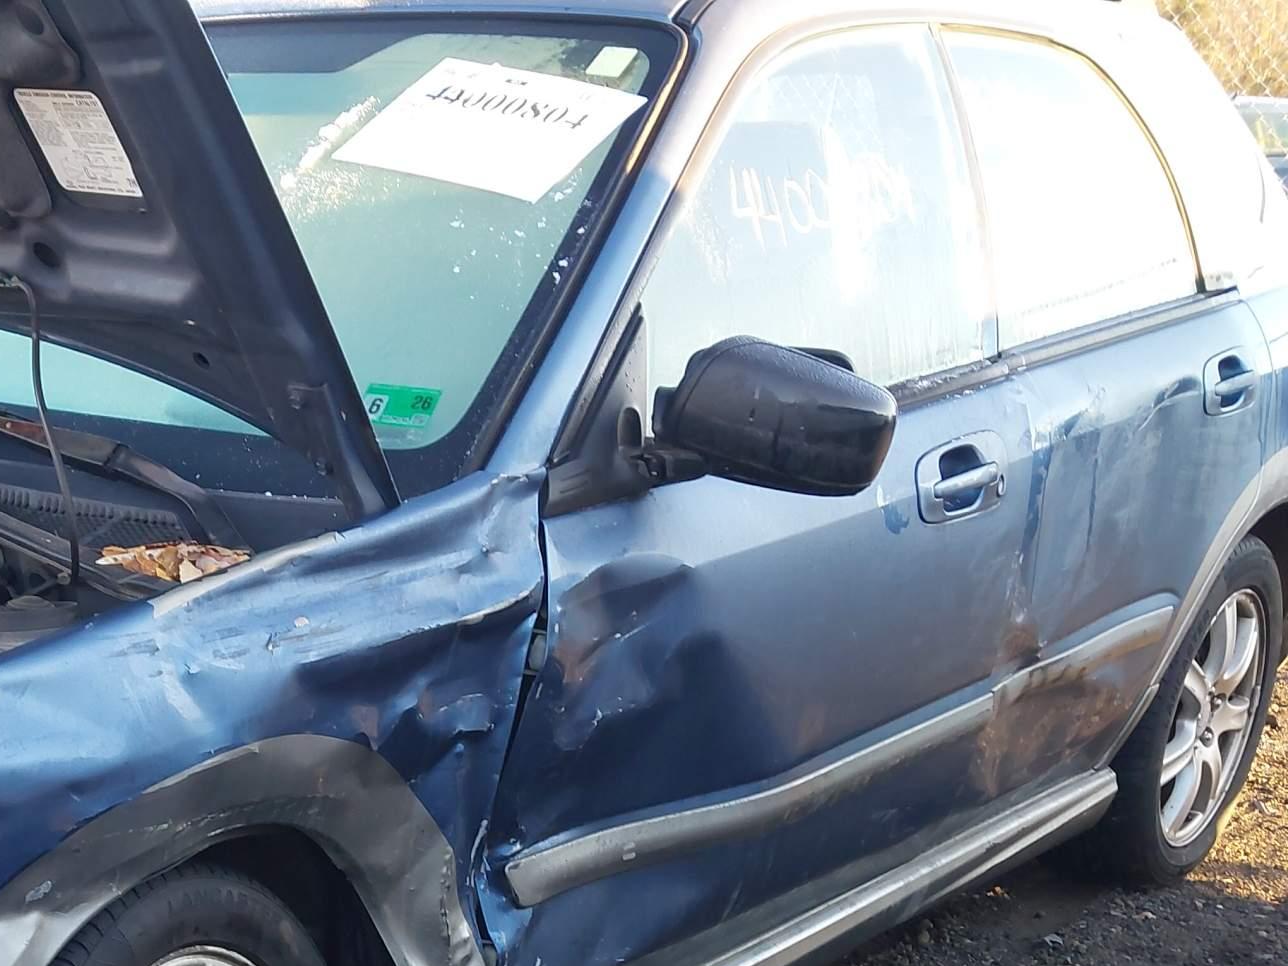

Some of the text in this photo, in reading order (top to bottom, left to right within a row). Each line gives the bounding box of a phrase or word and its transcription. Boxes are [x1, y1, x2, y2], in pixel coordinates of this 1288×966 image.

[425, 84, 589, 130] 44000804
[368, 395, 434, 415] 6 26
